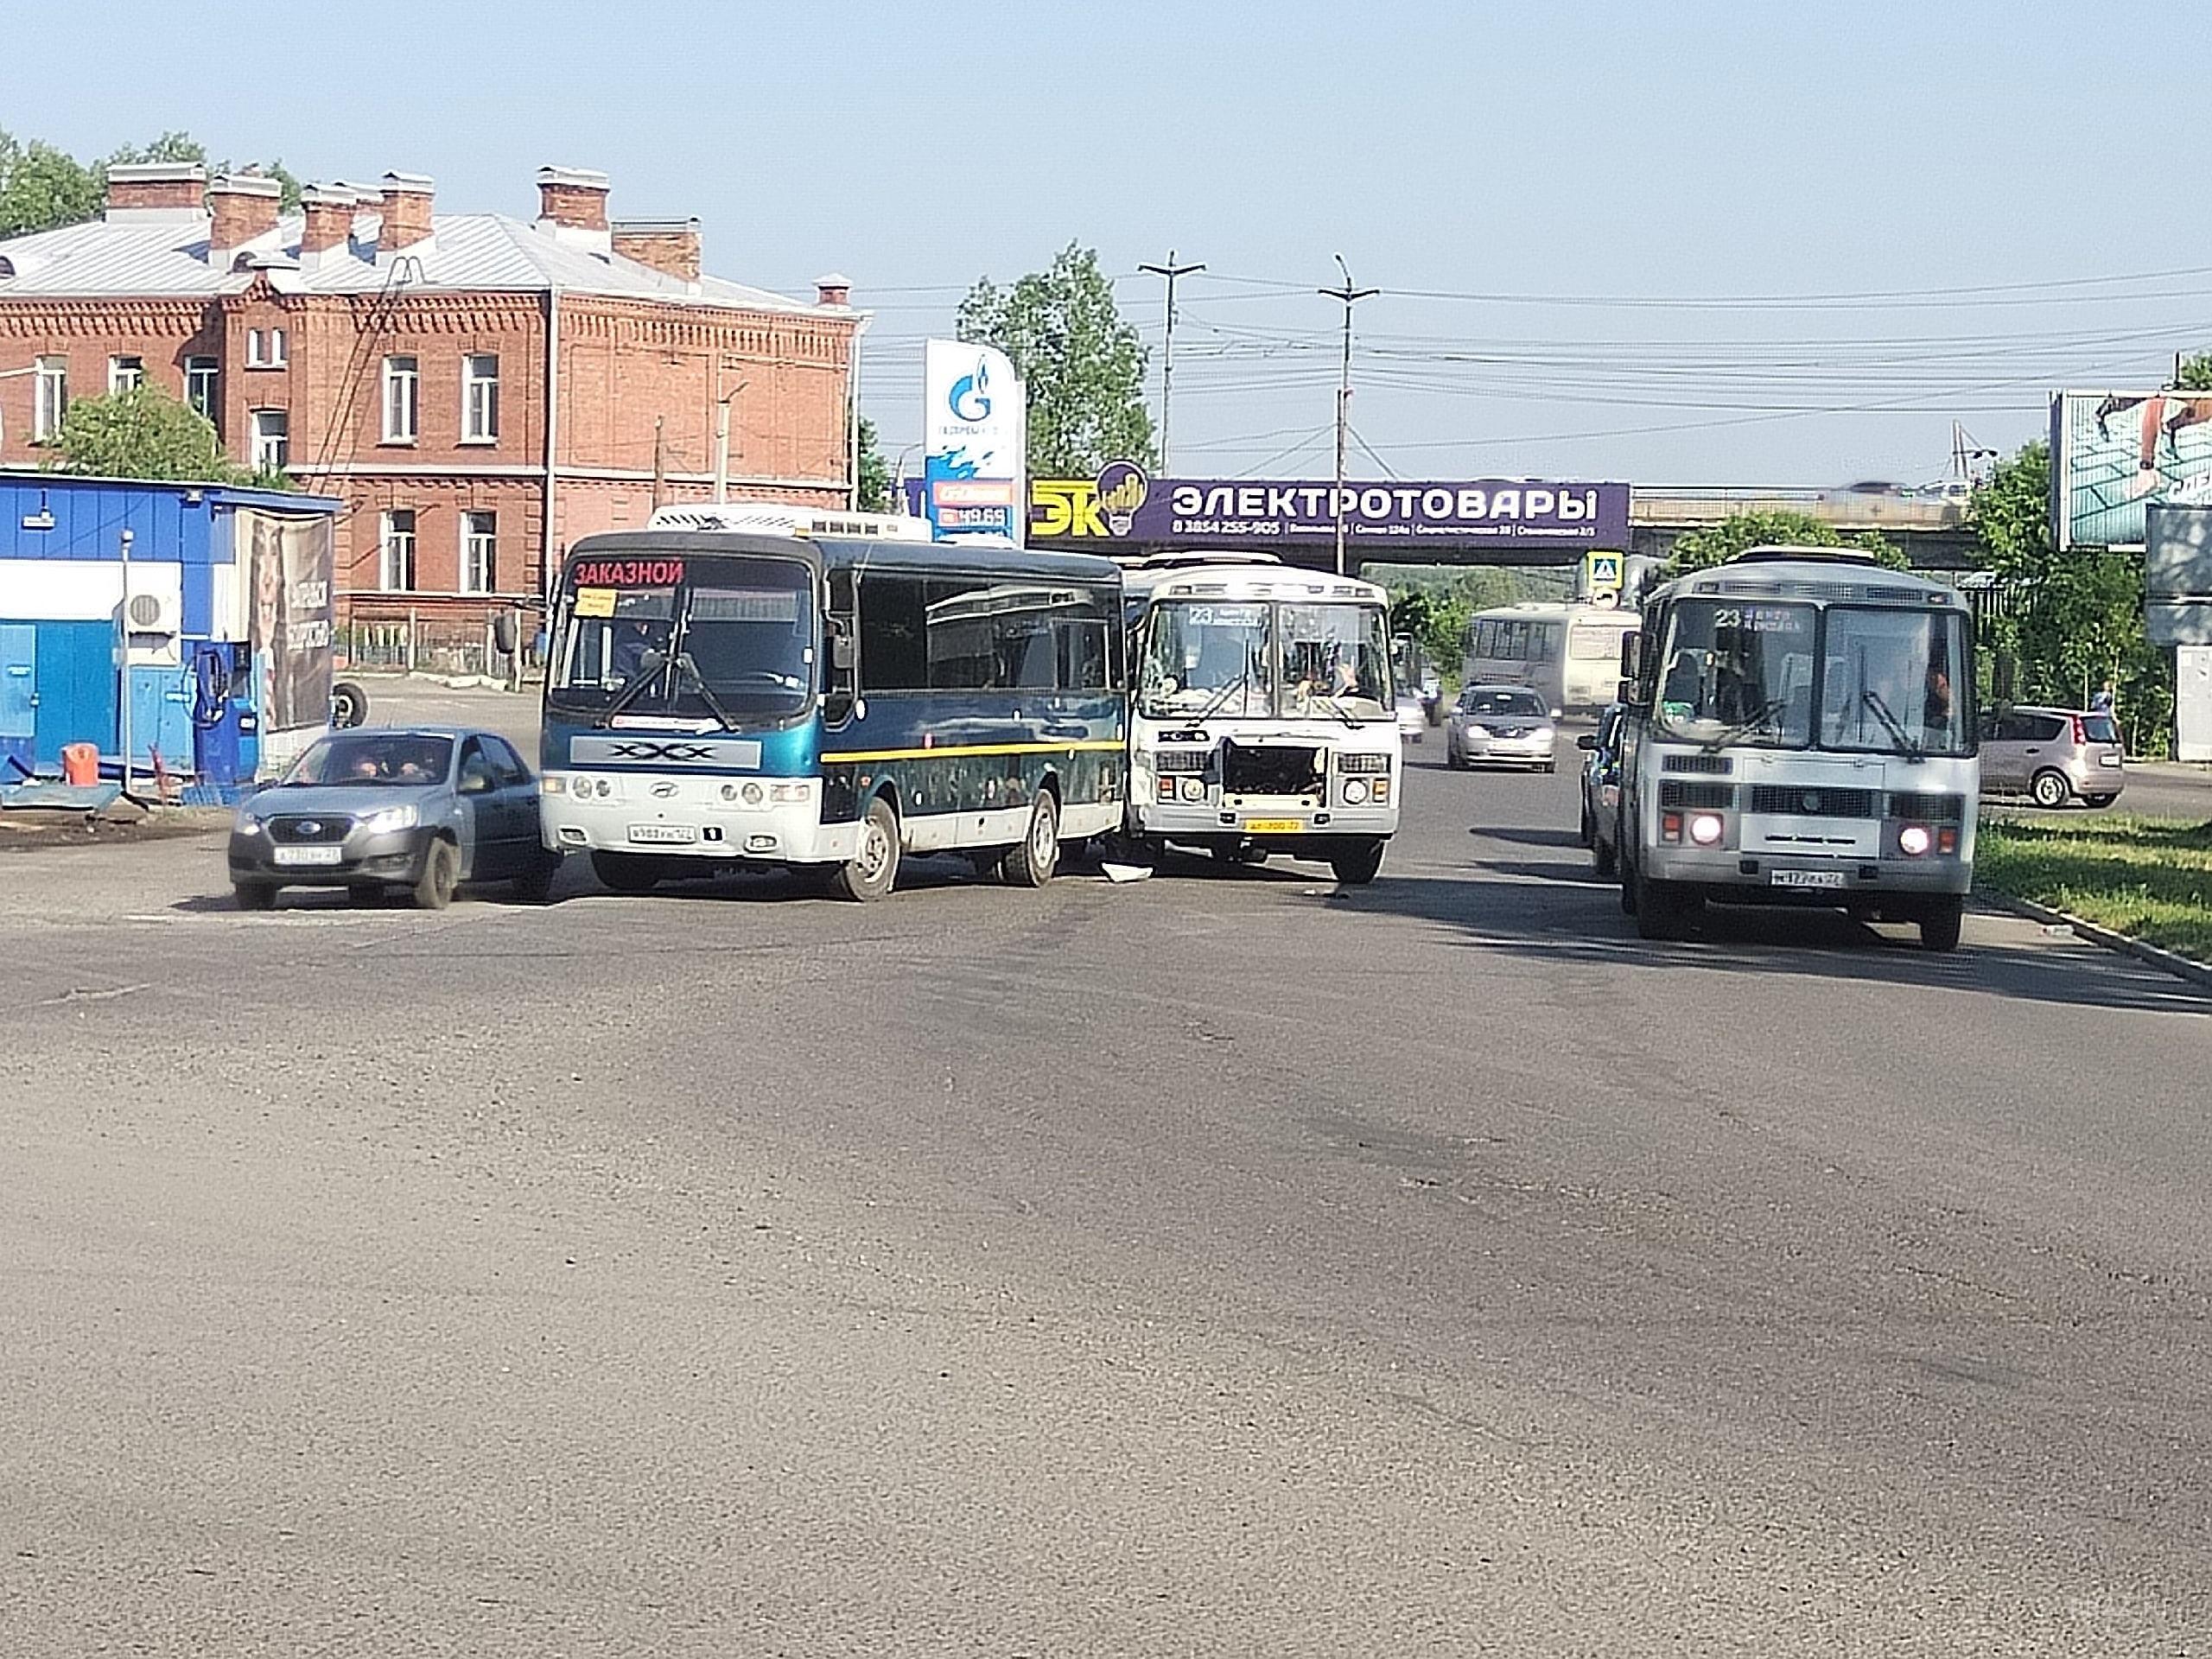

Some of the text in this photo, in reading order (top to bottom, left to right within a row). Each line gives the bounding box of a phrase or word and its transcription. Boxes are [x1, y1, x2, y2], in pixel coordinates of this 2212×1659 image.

[1173, 486, 1597, 519] ЭЛЕКТРОТОВАРЫ
[574, 557, 684, 584] ЗАКАЗНОЙ
[1714, 609, 1741, 628] 23
